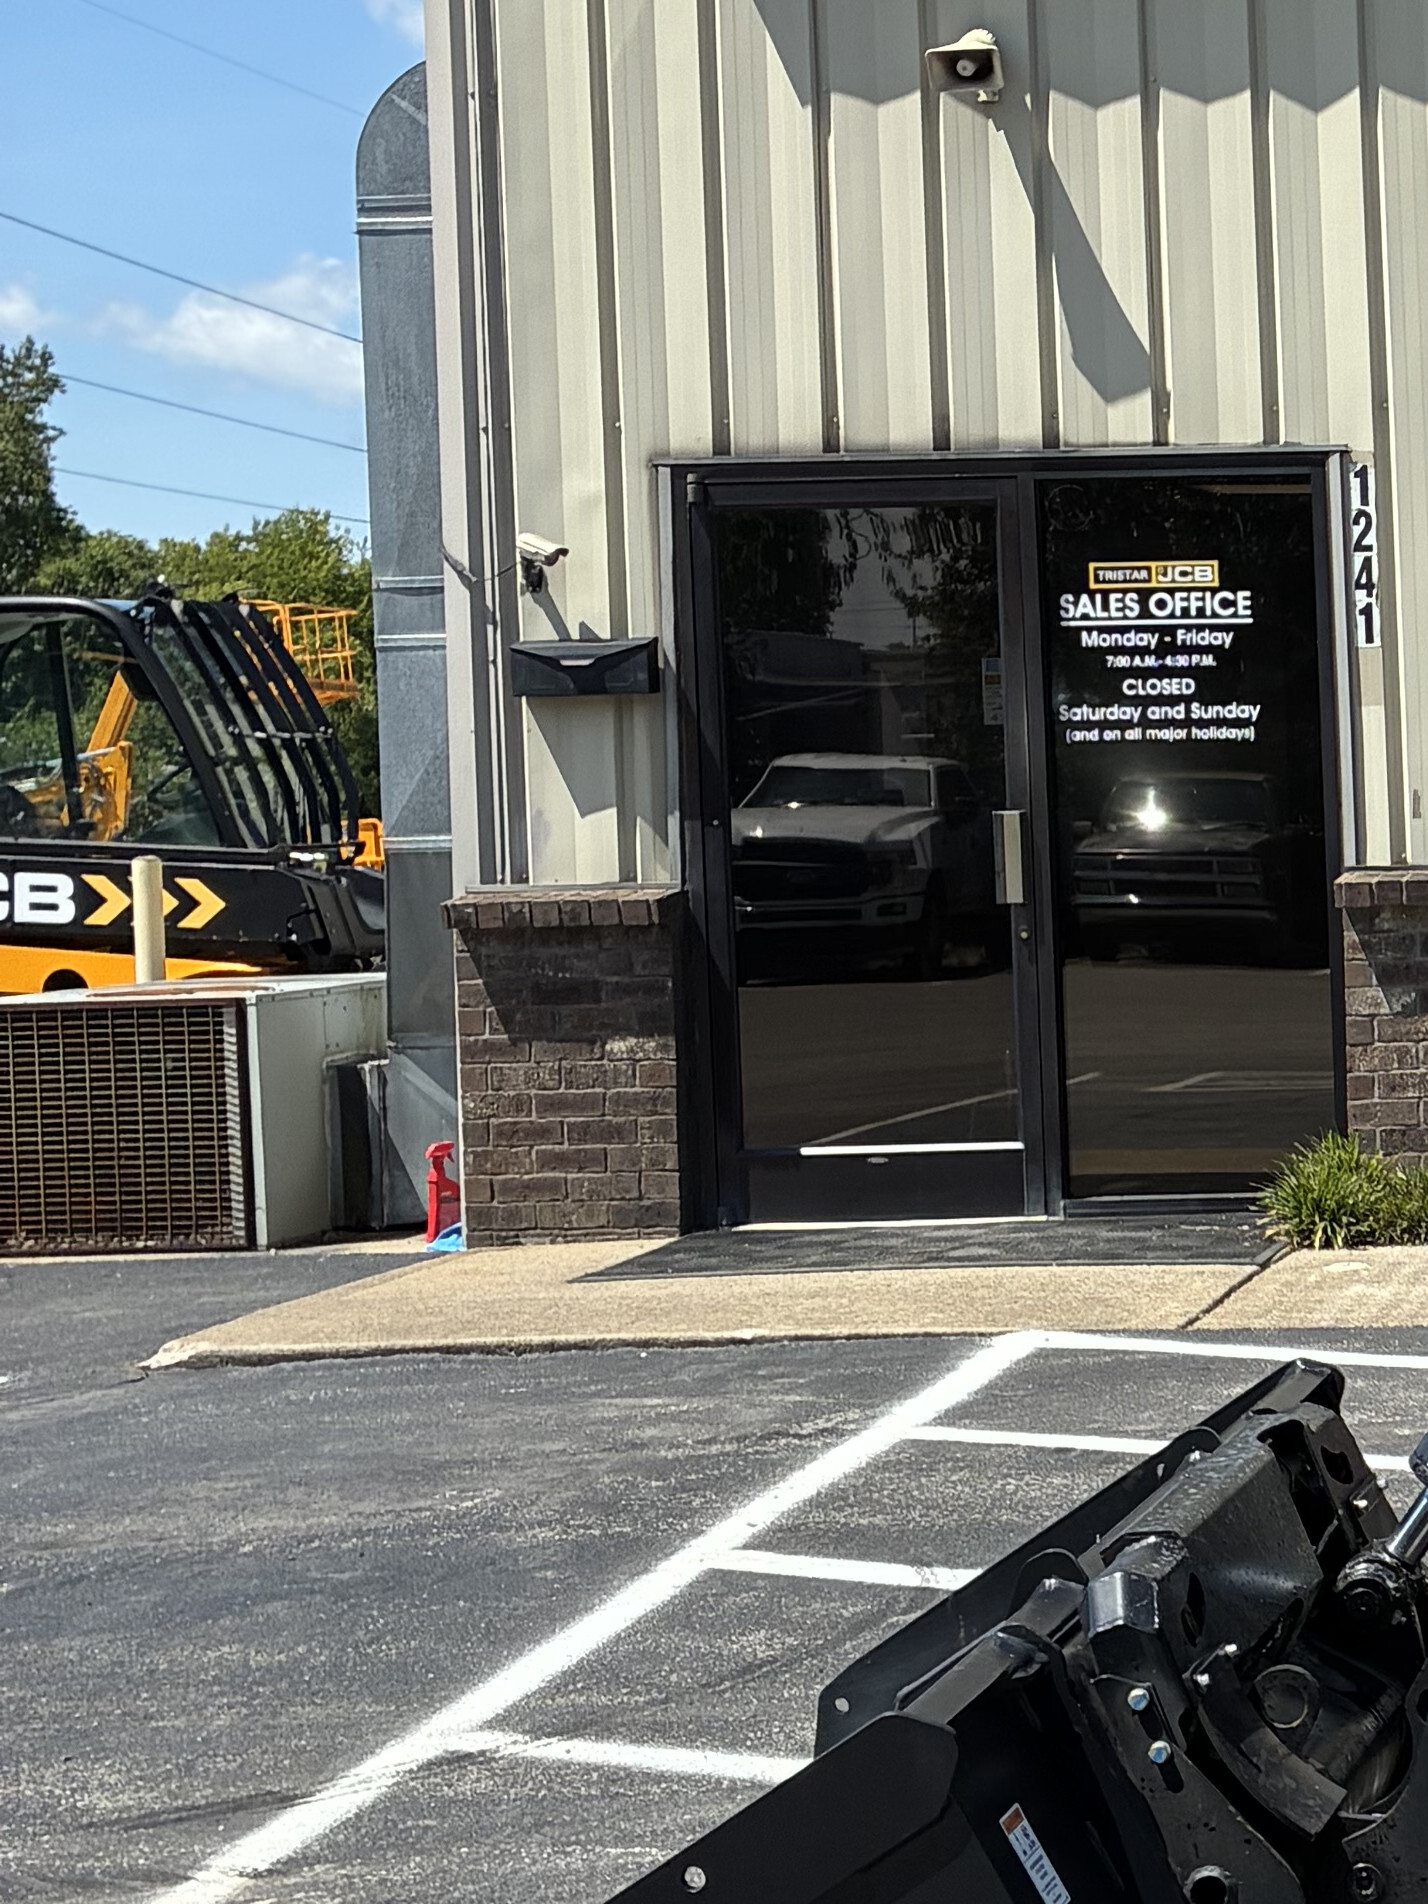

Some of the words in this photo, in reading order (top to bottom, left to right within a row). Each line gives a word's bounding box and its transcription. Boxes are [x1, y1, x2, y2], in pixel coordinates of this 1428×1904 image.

[1353, 464, 1376, 645] 1241
[1096, 569, 1149, 582] TRISTAR
[1157, 565, 1213, 582] JCB
[1059, 592, 1140, 618] SALES
[1148, 590, 1252, 617] OFFICE
[1080, 628, 1159, 650] Monday
[1176, 628, 1234, 649] Friday
[1122, 678, 1195, 696] CLOSED
[1058, 703, 1143, 723] Saturday
[1147, 702, 1185, 720] and
[1190, 701, 1261, 722] Sunday
[1065, 727, 1099, 744] (and
[1103, 731, 1121, 741] on
[1125, 727, 1142, 741] all
[1146, 727, 1188, 742] major
